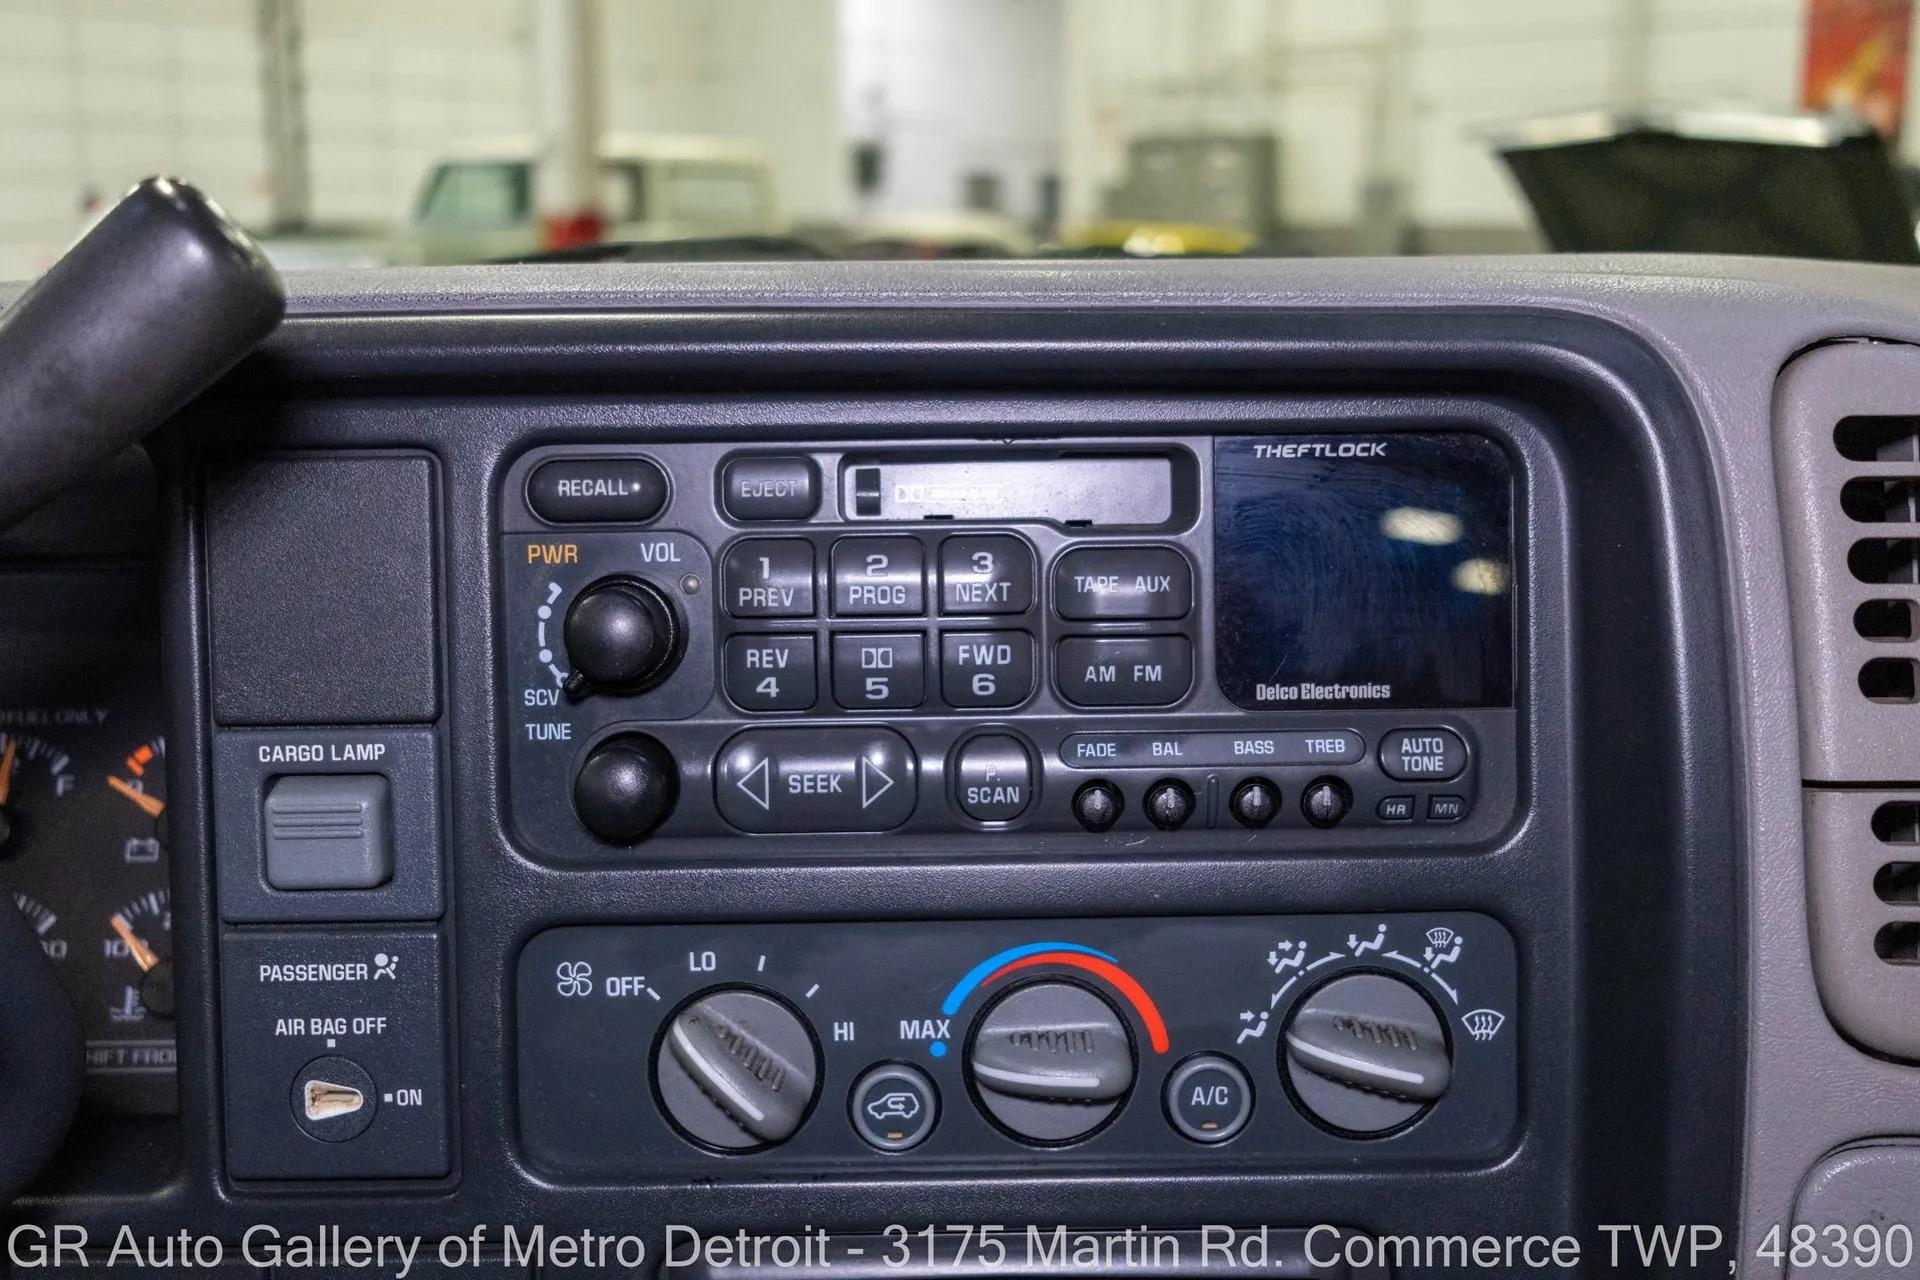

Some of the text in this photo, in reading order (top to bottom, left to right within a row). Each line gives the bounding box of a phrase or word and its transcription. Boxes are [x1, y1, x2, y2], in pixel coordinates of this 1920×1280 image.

[1253, 443, 1387, 458] THEFTLOCK
[558, 479, 629, 497] RECALL
[740, 480, 797, 498] EJECT
[527, 544, 578, 563] PWR
[640, 542, 681, 562] VOL
[759, 557, 770, 579] 1
[865, 555, 889, 577] 2
[971, 552, 994, 574] 3
[955, 582, 1011, 602] NEXT
[1074, 576, 1170, 593] TAPE AUX
[738, 588, 794, 607] PREV
[849, 586, 906, 605] PROG
[746, 649, 789, 668] REV
[958, 645, 1011, 665] FWD
[1085, 665, 1162, 682] AM FM
[756, 677, 780, 697] 4
[865, 677, 889, 700] 5
[971, 673, 996, 696] 6
[1256, 682, 1391, 700] Delco Electronics
[524, 689, 560, 706] SCV
[525, 723, 571, 740] TUNE
[258, 744, 386, 763] CARGO LAMP
[1077, 743, 1116, 757] FADE
[1152, 742, 1183, 757] BAL
[1234, 740, 1274, 755] BASS
[1305, 739, 1345, 753] TREB
[1401, 738, 1443, 754] AUTO
[1402, 755, 1443, 772] TONE
[985, 765, 1001, 781] P.
[788, 774, 842, 793] SEEK
[967, 786, 1019, 804] SCAN
[1386, 804, 1406, 815] HR
[1434, 802, 1459, 814] MN
[689, 952, 716, 971] LO
[260, 964, 368, 982] PASSENGER
[606, 976, 645, 997] OFF
[275, 1018, 387, 1036] AIR BAG OFF
[834, 1023, 855, 1041] HI
[900, 1020, 950, 1039] MAX
[397, 1090, 423, 1106] ON
[1191, 1086, 1229, 1106] A/C
